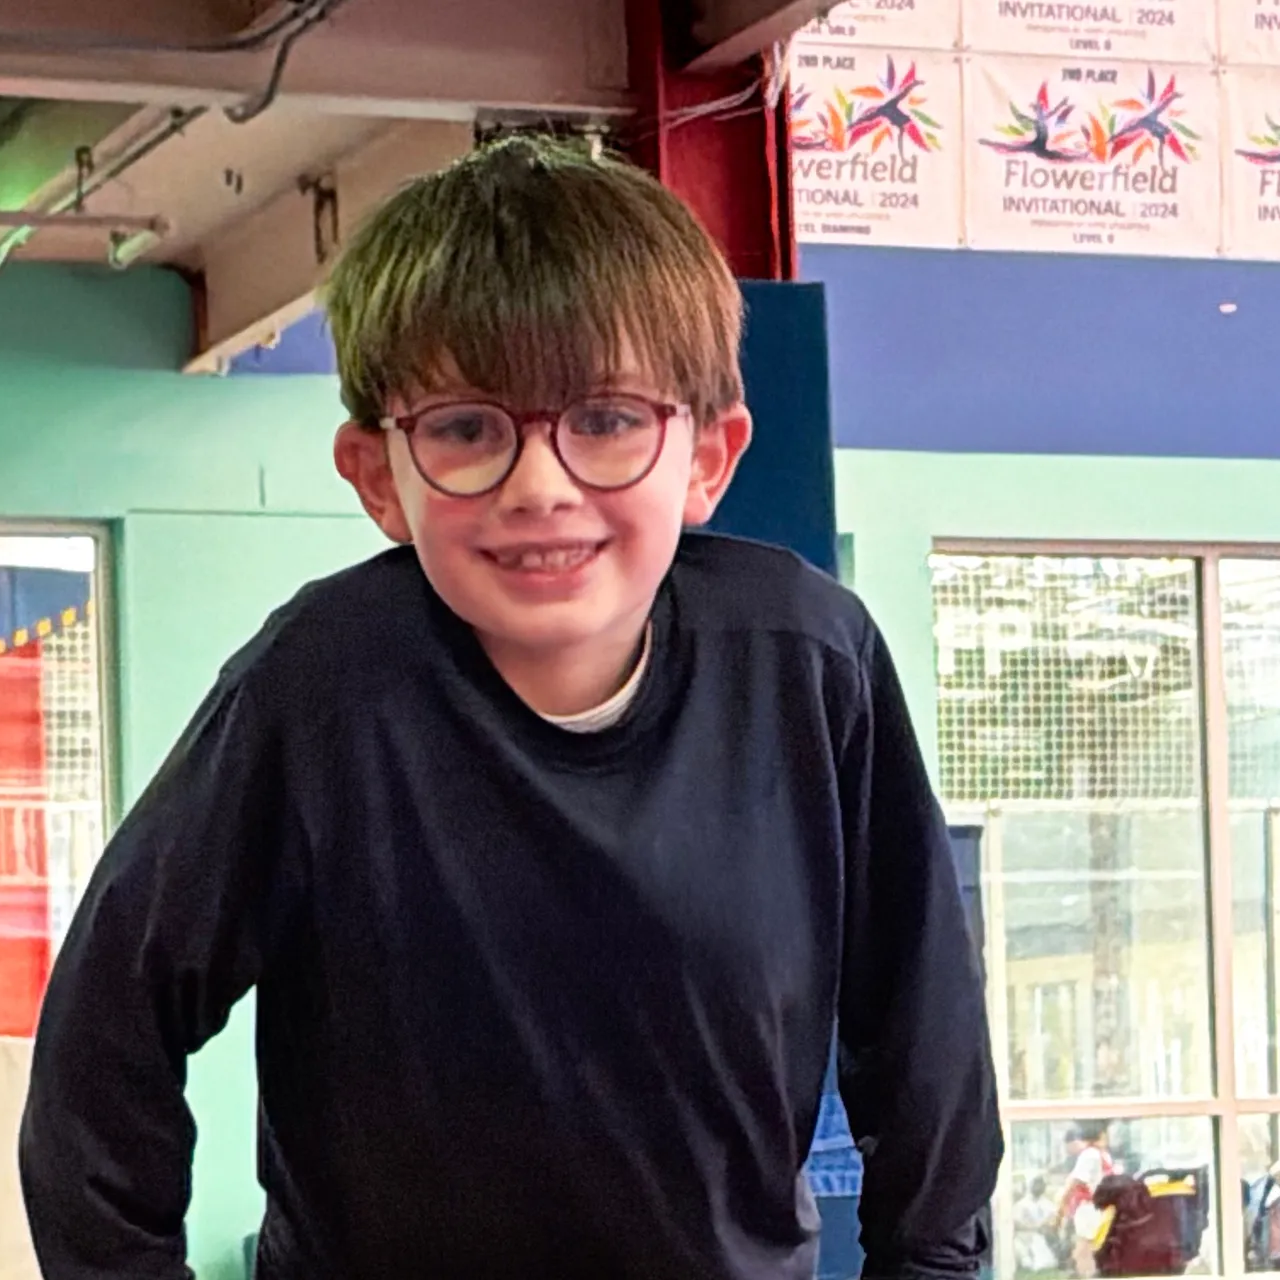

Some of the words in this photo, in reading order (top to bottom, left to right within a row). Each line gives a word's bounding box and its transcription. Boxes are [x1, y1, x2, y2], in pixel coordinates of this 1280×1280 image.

[998, 1, 1122, 22] INVITATIONAL
[1136, 9, 1175, 25] 2024
[822, 56, 856, 71] PLACE
[1085, 69, 1118, 84] PLACE
[1004, 159, 1178, 194] Flowerfield
[879, 192, 919, 209] 2024
[1002, 196, 1126, 218] INVITATIONAL
[1139, 202, 1179, 218] 2024
